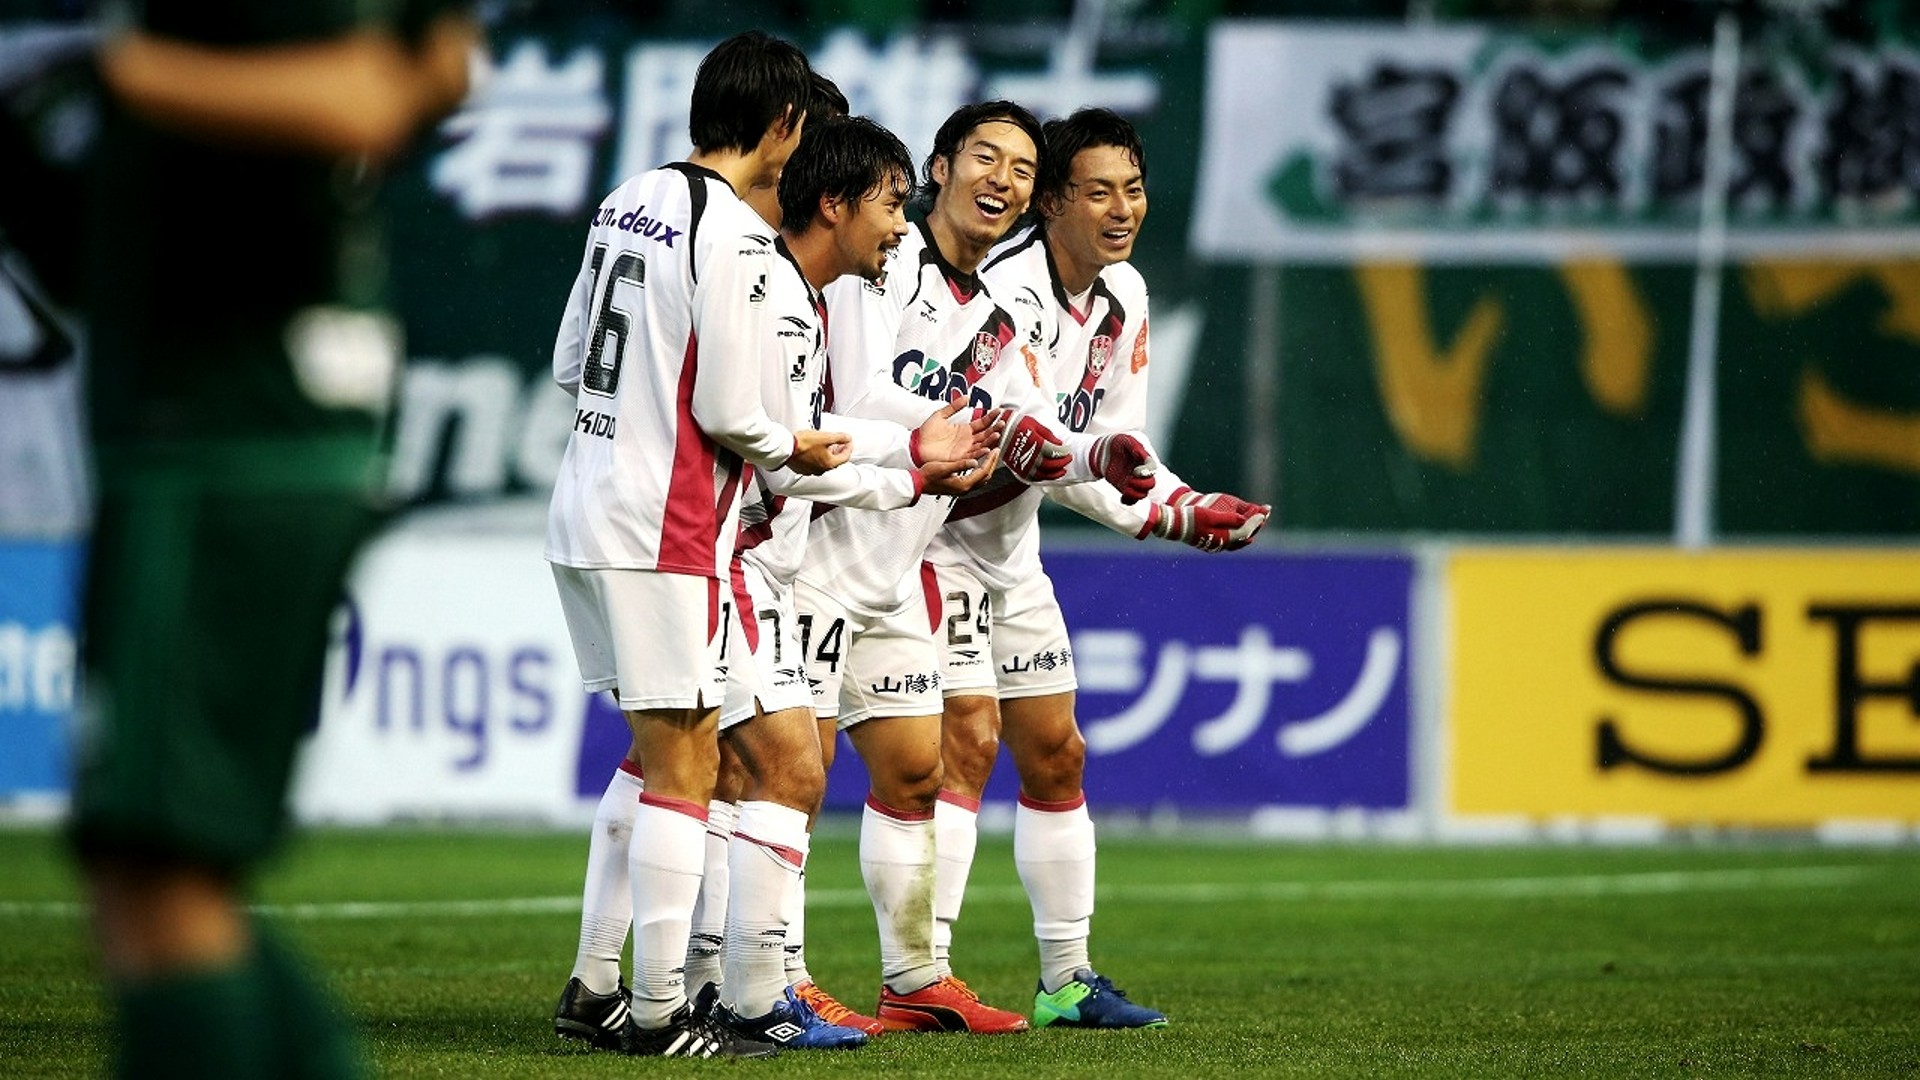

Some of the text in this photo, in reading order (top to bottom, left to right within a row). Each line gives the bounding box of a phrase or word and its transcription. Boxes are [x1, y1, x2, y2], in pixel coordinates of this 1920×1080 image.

[582, 242, 646, 399] 16
[797, 614, 845, 673] 14
[945, 590, 991, 645] 24
[1074, 625, 1400, 758] シナノ
